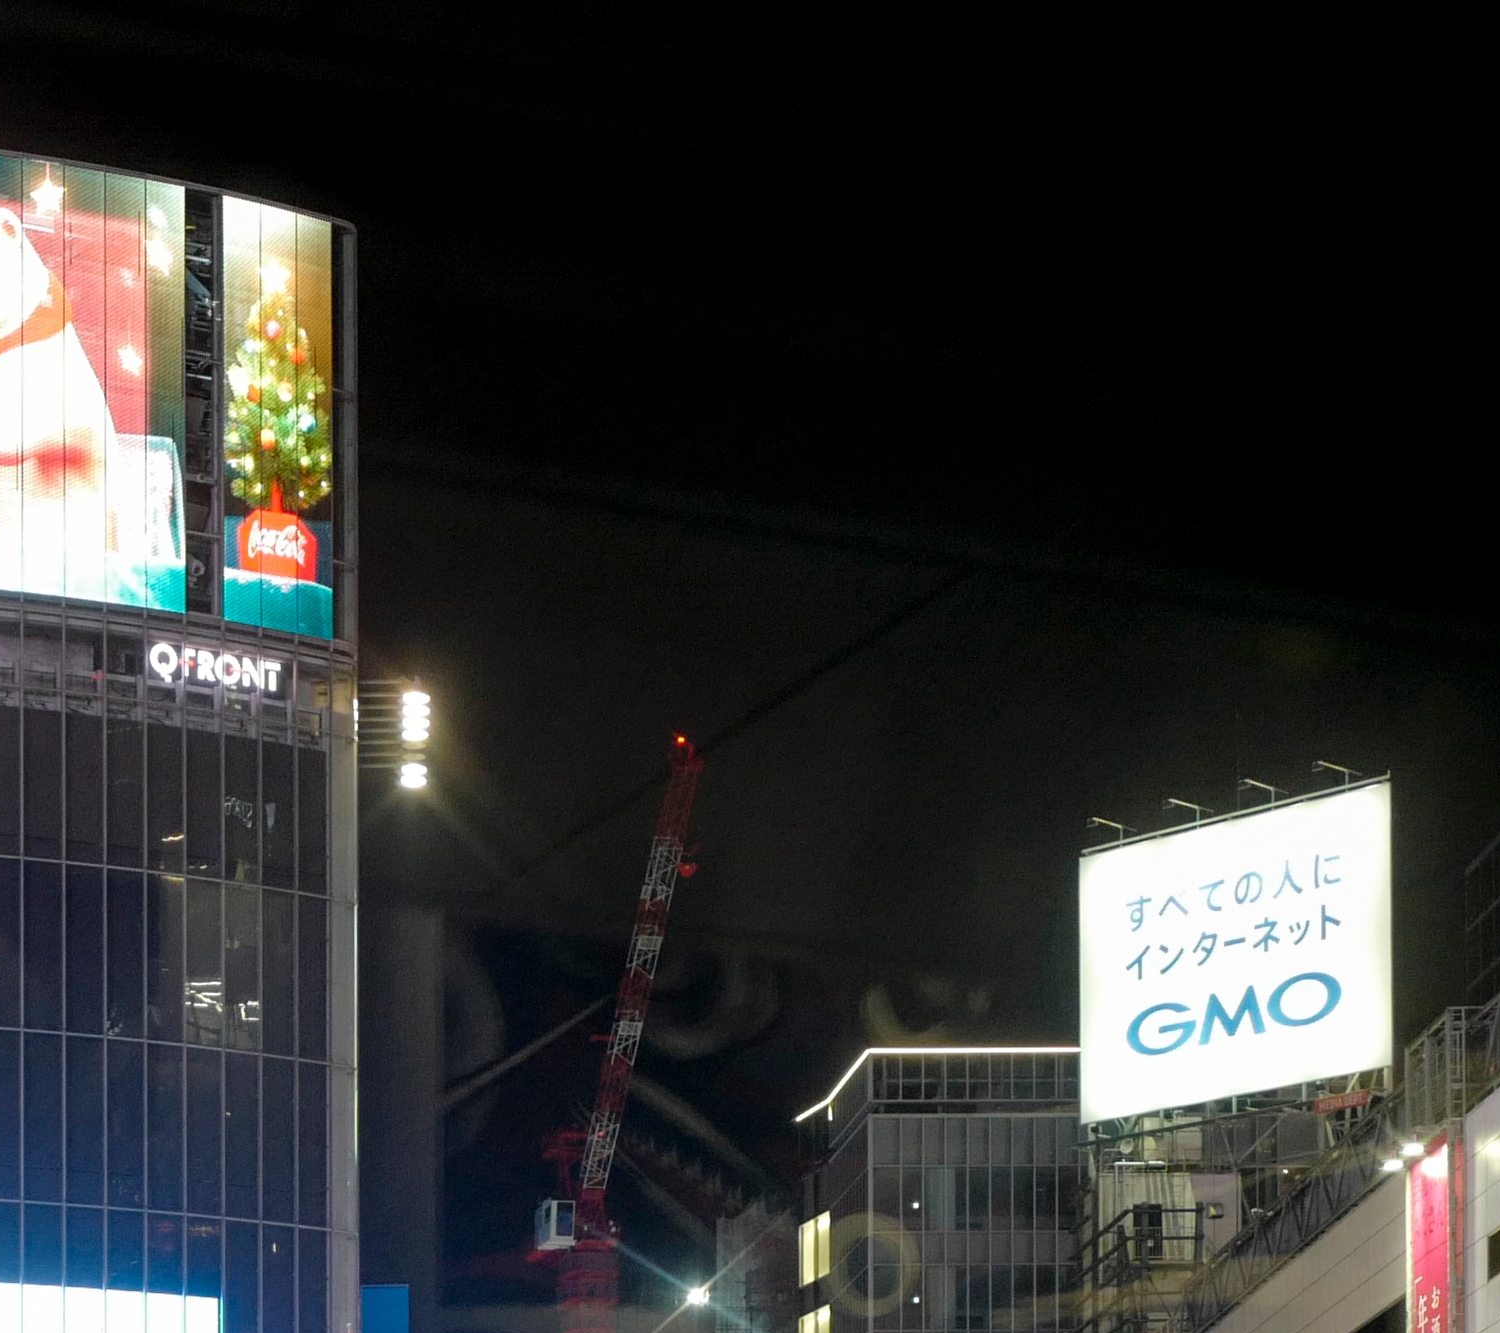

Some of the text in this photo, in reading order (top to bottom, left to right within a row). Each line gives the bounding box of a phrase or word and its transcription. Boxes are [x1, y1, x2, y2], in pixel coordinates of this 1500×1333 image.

[1125, 853, 1342, 932] すべての人に
[1125, 904, 1342, 980] インターネット
[1126, 971, 1342, 1056] GMO
